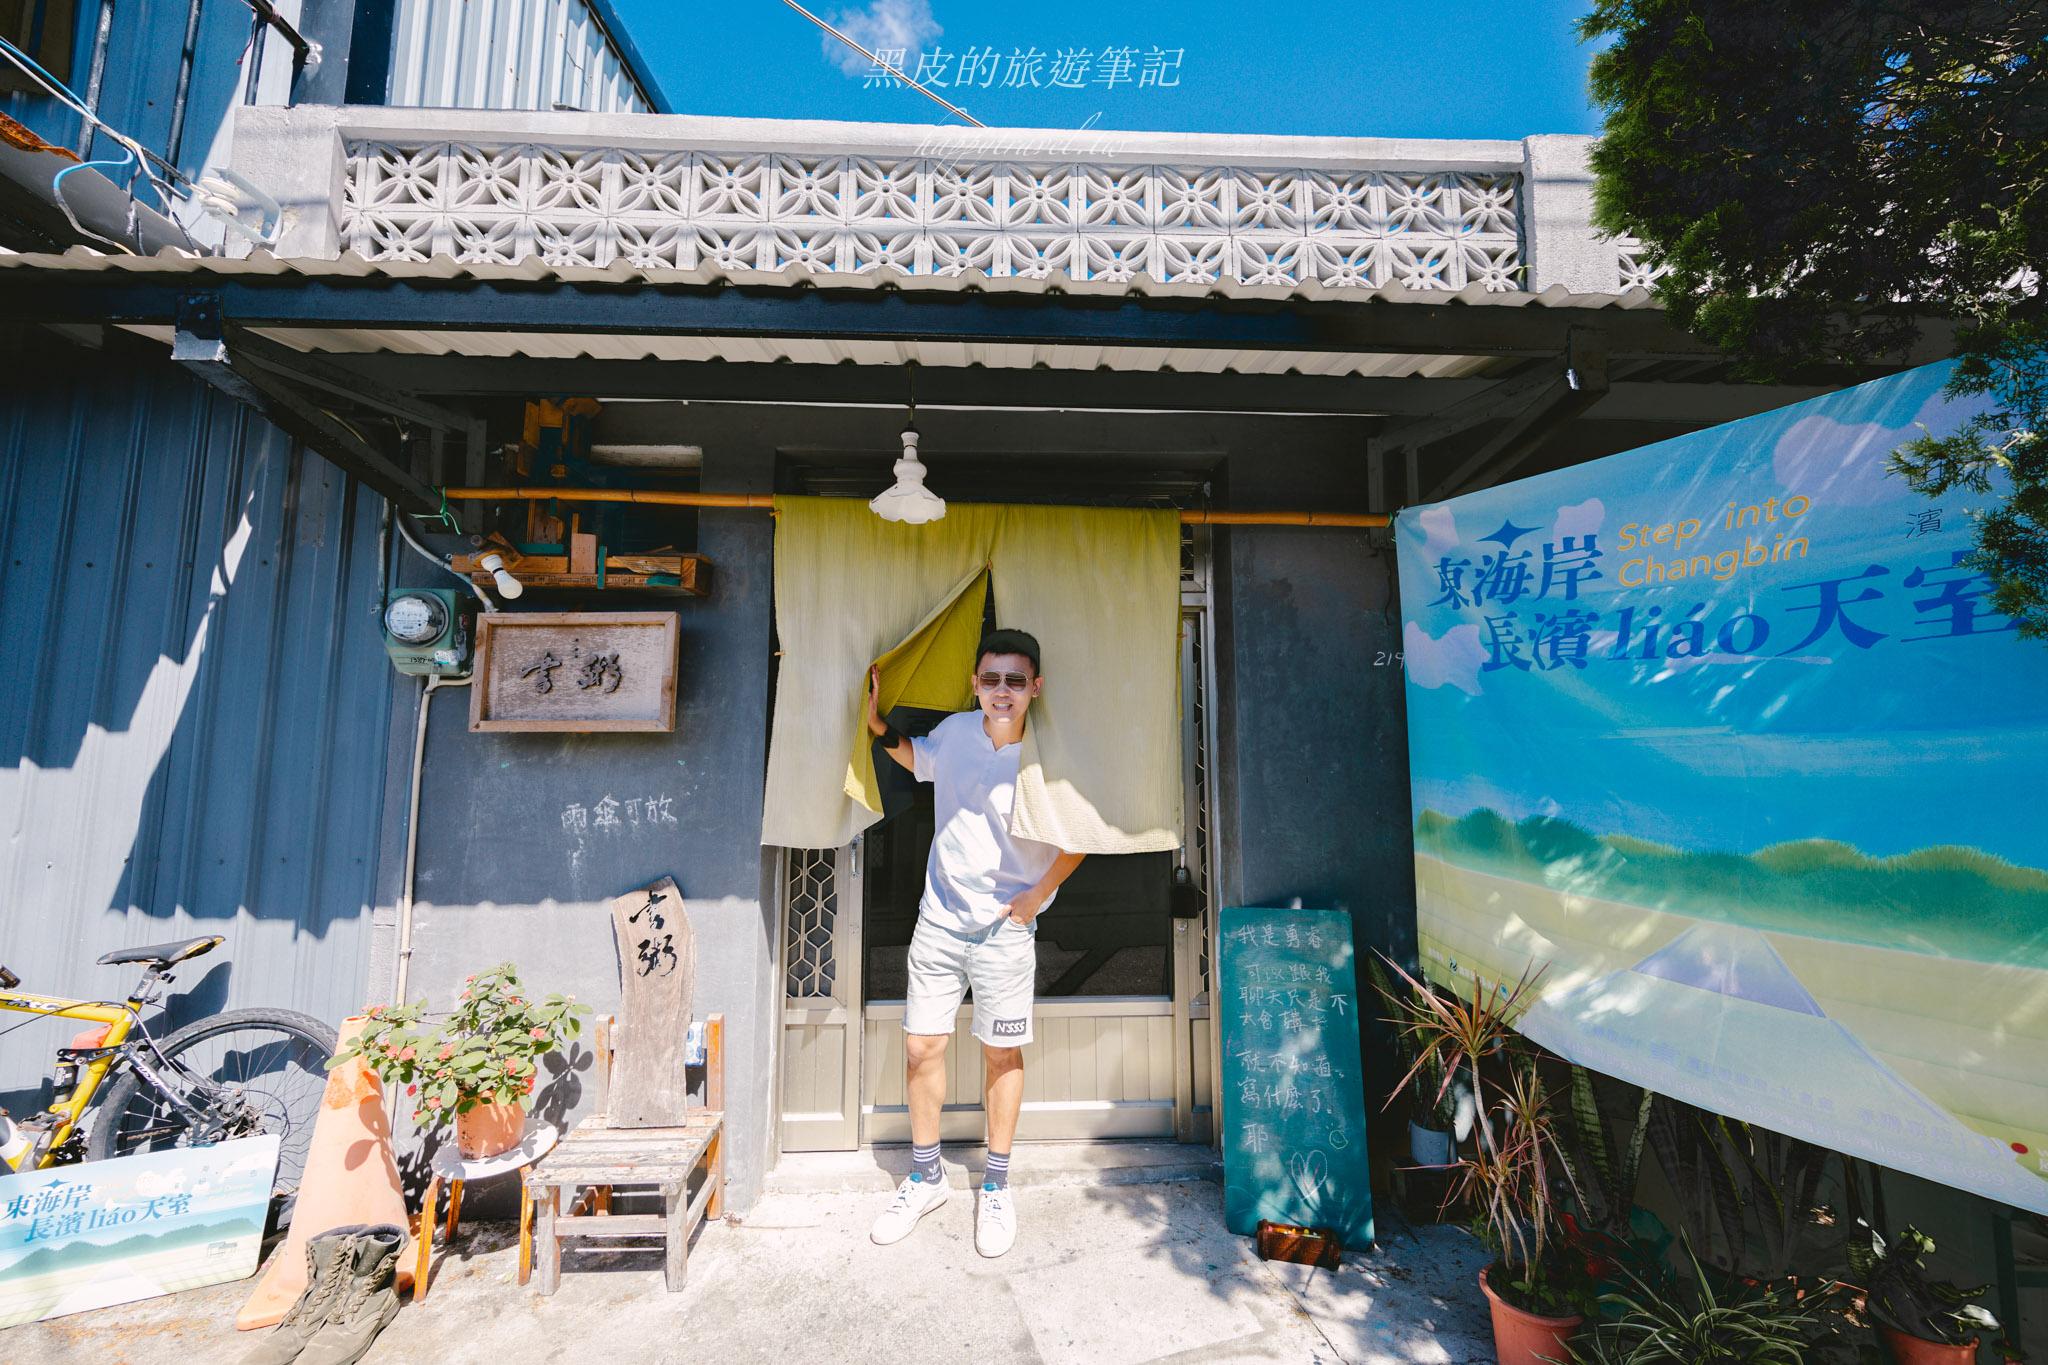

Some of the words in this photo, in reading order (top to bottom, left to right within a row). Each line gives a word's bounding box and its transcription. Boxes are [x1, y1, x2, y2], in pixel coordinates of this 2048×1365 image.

[1617, 518, 1701, 551] Step
[1725, 494, 1810, 530] into
[1425, 534, 1603, 610] 東海岸
[1617, 533, 1810, 588] Changbin
[1373, 651, 1404, 670] 219
[561, 793, 677, 832] 雨傘可放
[1245, 963, 1333, 985] 可以跟我
[1242, 1123, 1269, 1153] 耶
[3, 1184, 92, 1219] 東海岸
